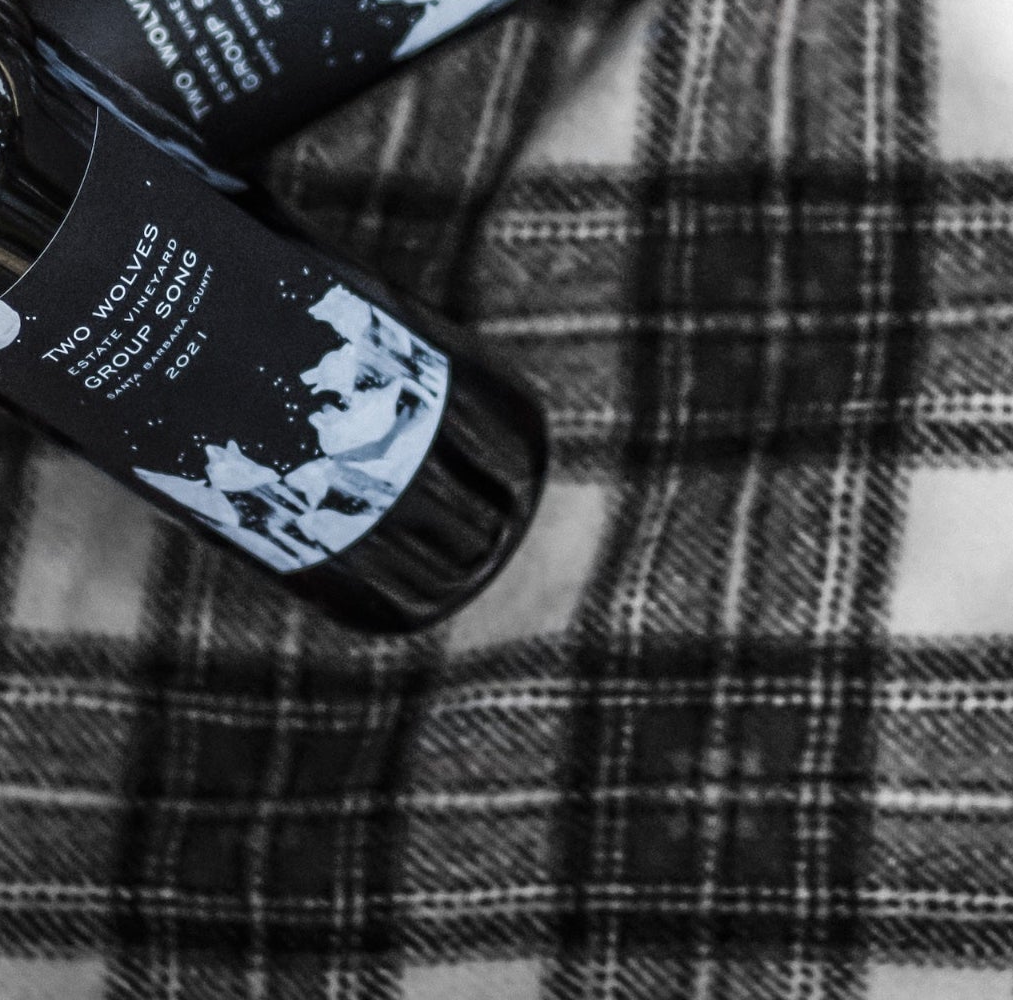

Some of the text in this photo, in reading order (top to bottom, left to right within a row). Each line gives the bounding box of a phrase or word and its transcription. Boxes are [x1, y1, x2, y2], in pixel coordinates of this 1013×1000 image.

[174, 71, 211, 120] TWO
[196, 45, 234, 102] ESTATE
[205, 15, 259, 90] GROUP
[42, 223, 159, 363] TWO WOLVES
[68, 238, 177, 376] ESTATE VINEYARD
[84, 250, 197, 389] GROUP SONG
[106, 264, 214, 400] SANTA BARBARA COUNTY
[165, 330, 207, 380] 2021
